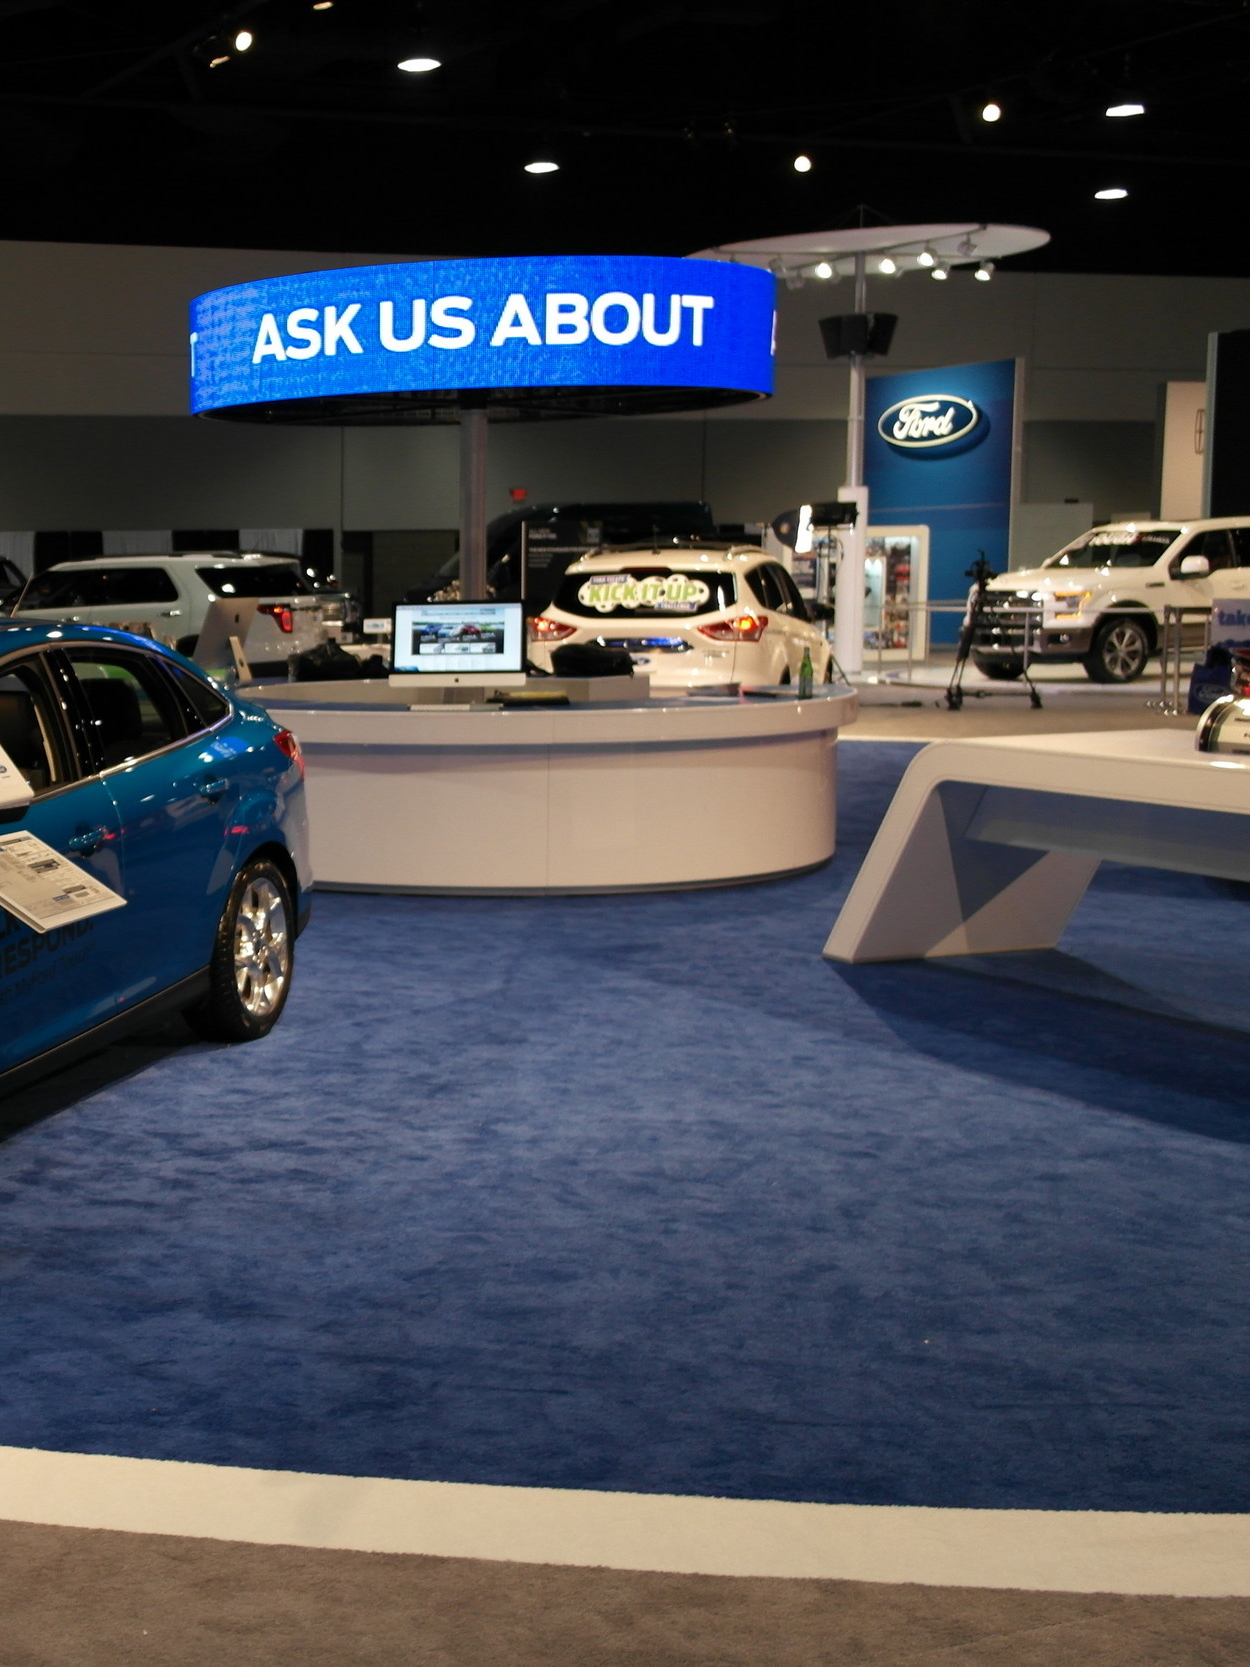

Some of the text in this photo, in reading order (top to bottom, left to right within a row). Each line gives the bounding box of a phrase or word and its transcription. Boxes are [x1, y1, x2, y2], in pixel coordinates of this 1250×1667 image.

[251, 302, 365, 365] ASK
[378, 294, 478, 353] US
[488, 291, 716, 348] ABOUT
[893, 401, 956, 440] Ford
[588, 583, 698, 602] KICK IT UP
